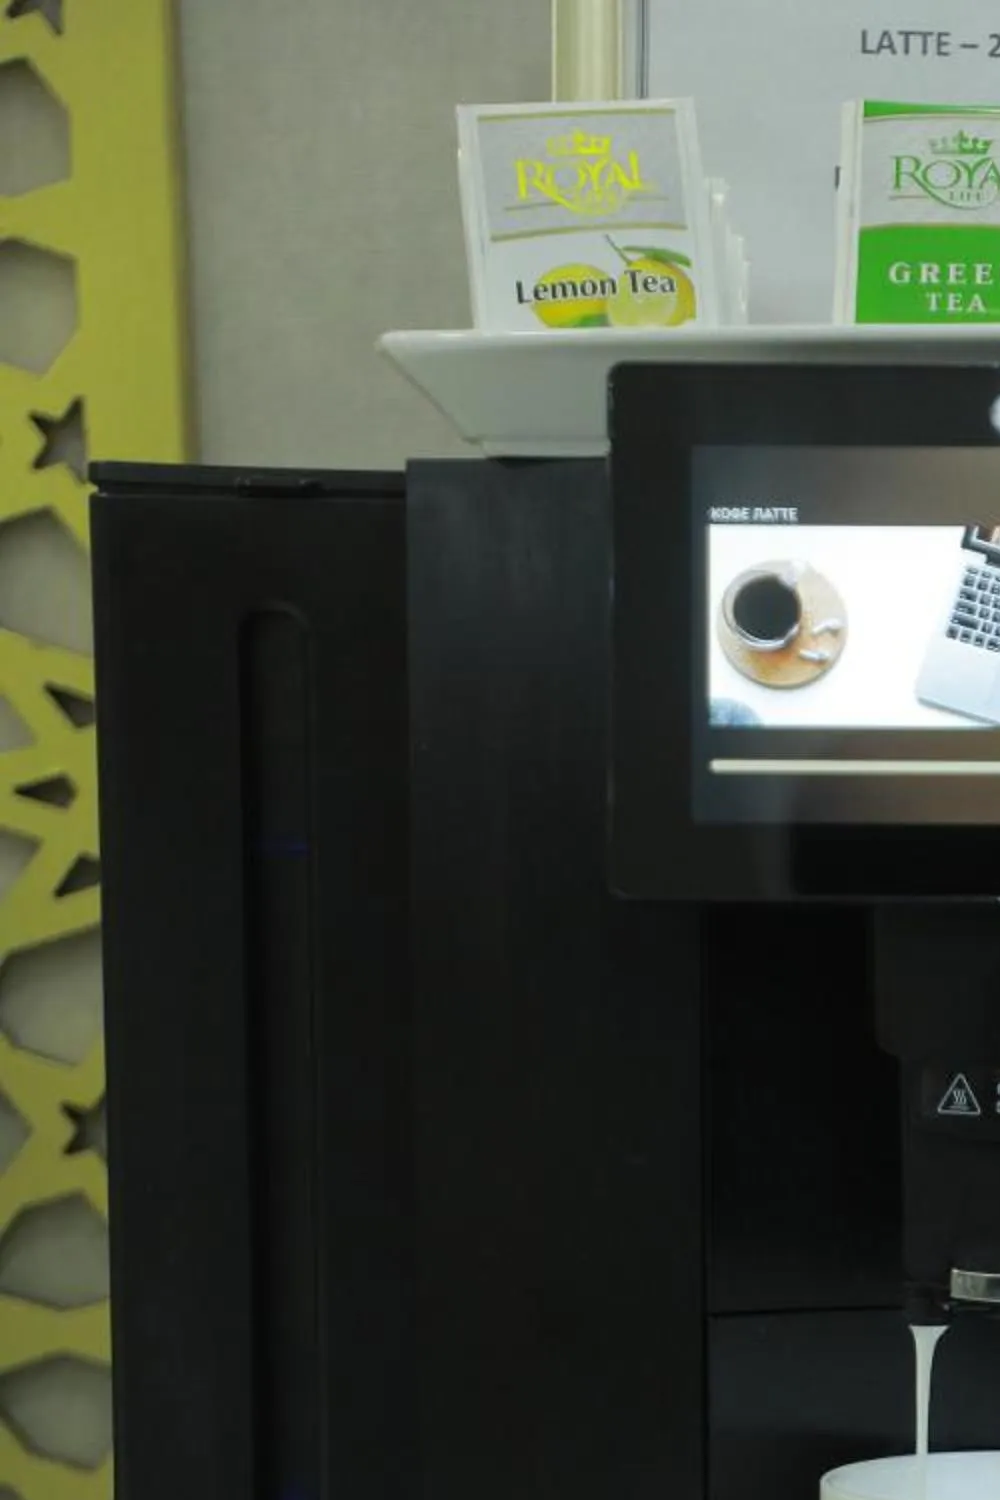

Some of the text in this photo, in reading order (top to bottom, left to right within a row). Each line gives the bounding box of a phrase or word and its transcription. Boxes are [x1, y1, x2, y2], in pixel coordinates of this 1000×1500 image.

[860, 29, 951, 56] LATTE
[515, 150, 644, 214] ROYAL
[515, 269, 675, 304] Lemon Tea
[926, 291, 987, 314] TEA
[710, 507, 799, 522] КОФЕ ЛАТТЕ
